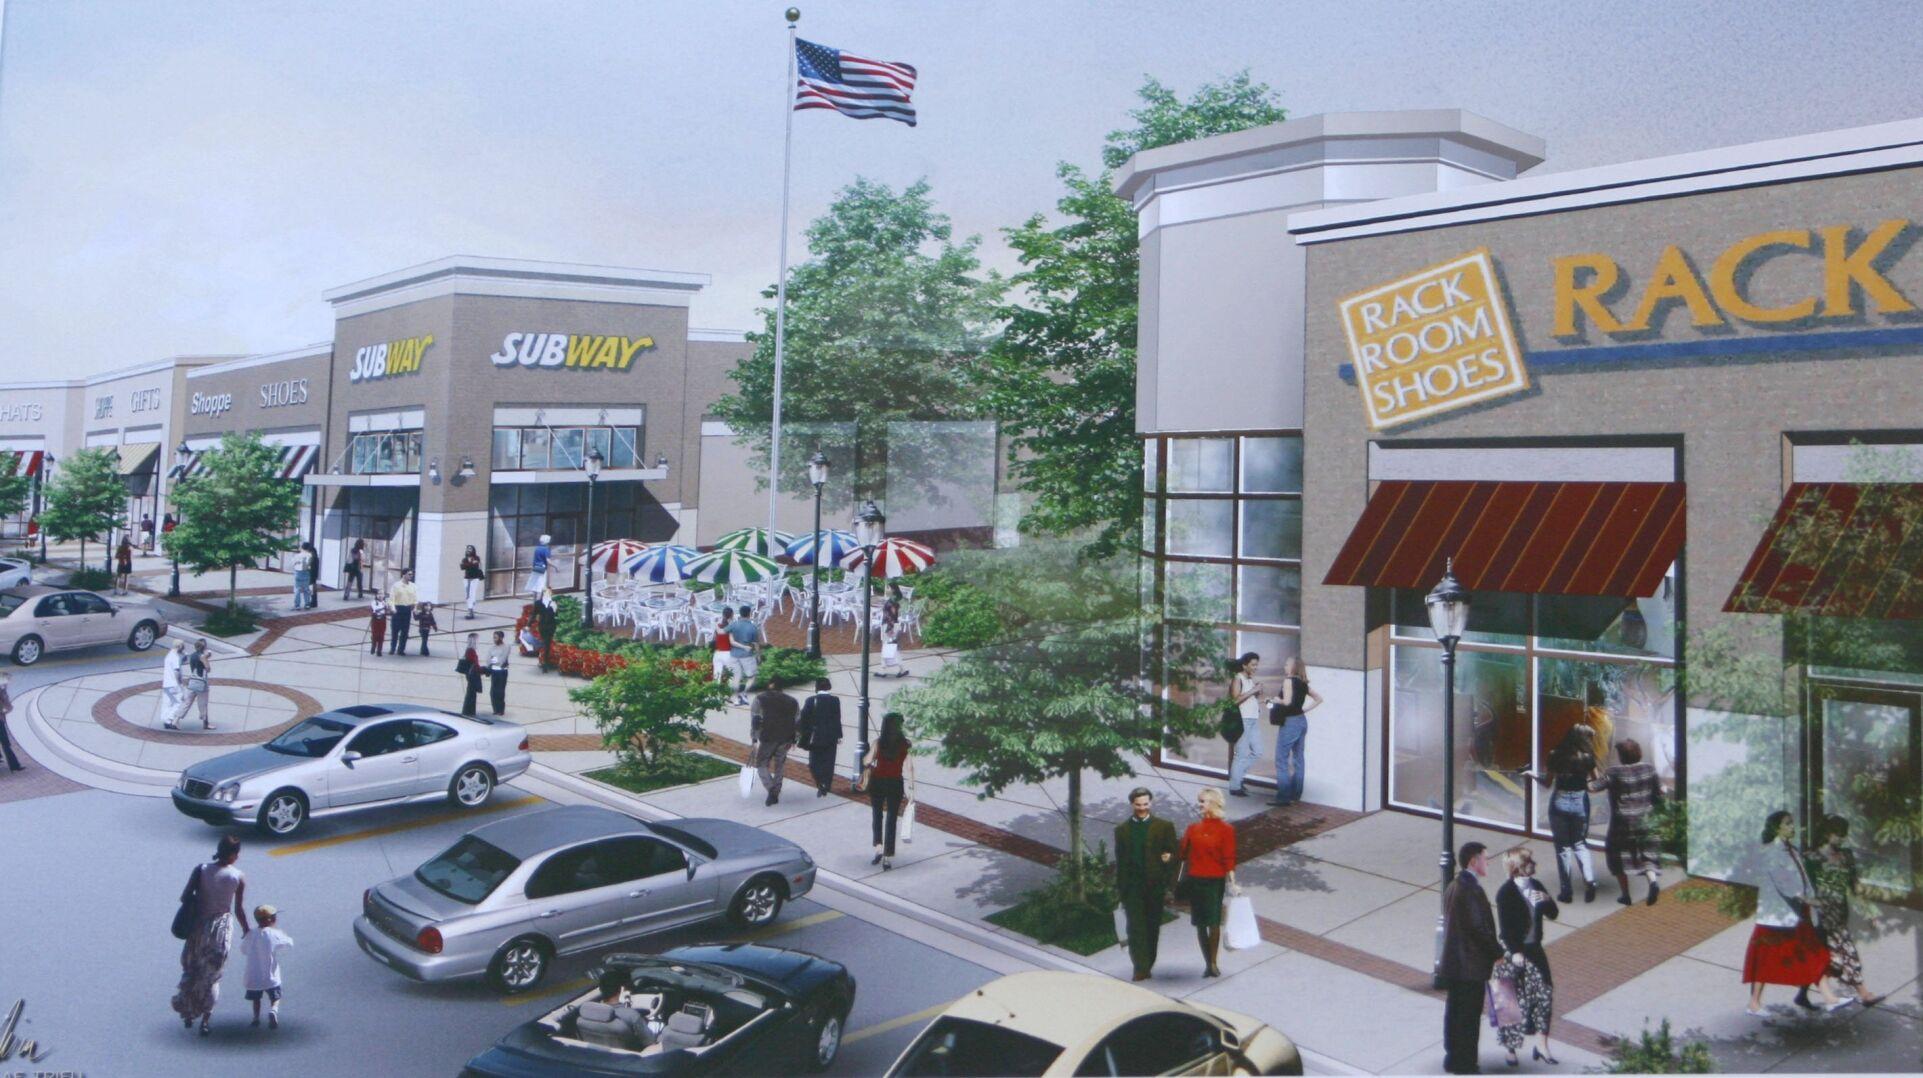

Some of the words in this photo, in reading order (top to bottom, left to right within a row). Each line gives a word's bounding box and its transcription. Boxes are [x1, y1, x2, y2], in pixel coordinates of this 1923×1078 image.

[1550, 218, 1917, 336] RACK
[1361, 272, 1472, 334] RACK
[351, 335, 433, 382] SUBWAY
[490, 332, 656, 369] SUBWAY
[1363, 308, 1494, 374] ROOM
[130, 388, 160, 413] GIFTS
[191, 391, 232, 418] Shoppe
[259, 379, 308, 408] SHOES
[1372, 348, 1505, 414] SHOES
